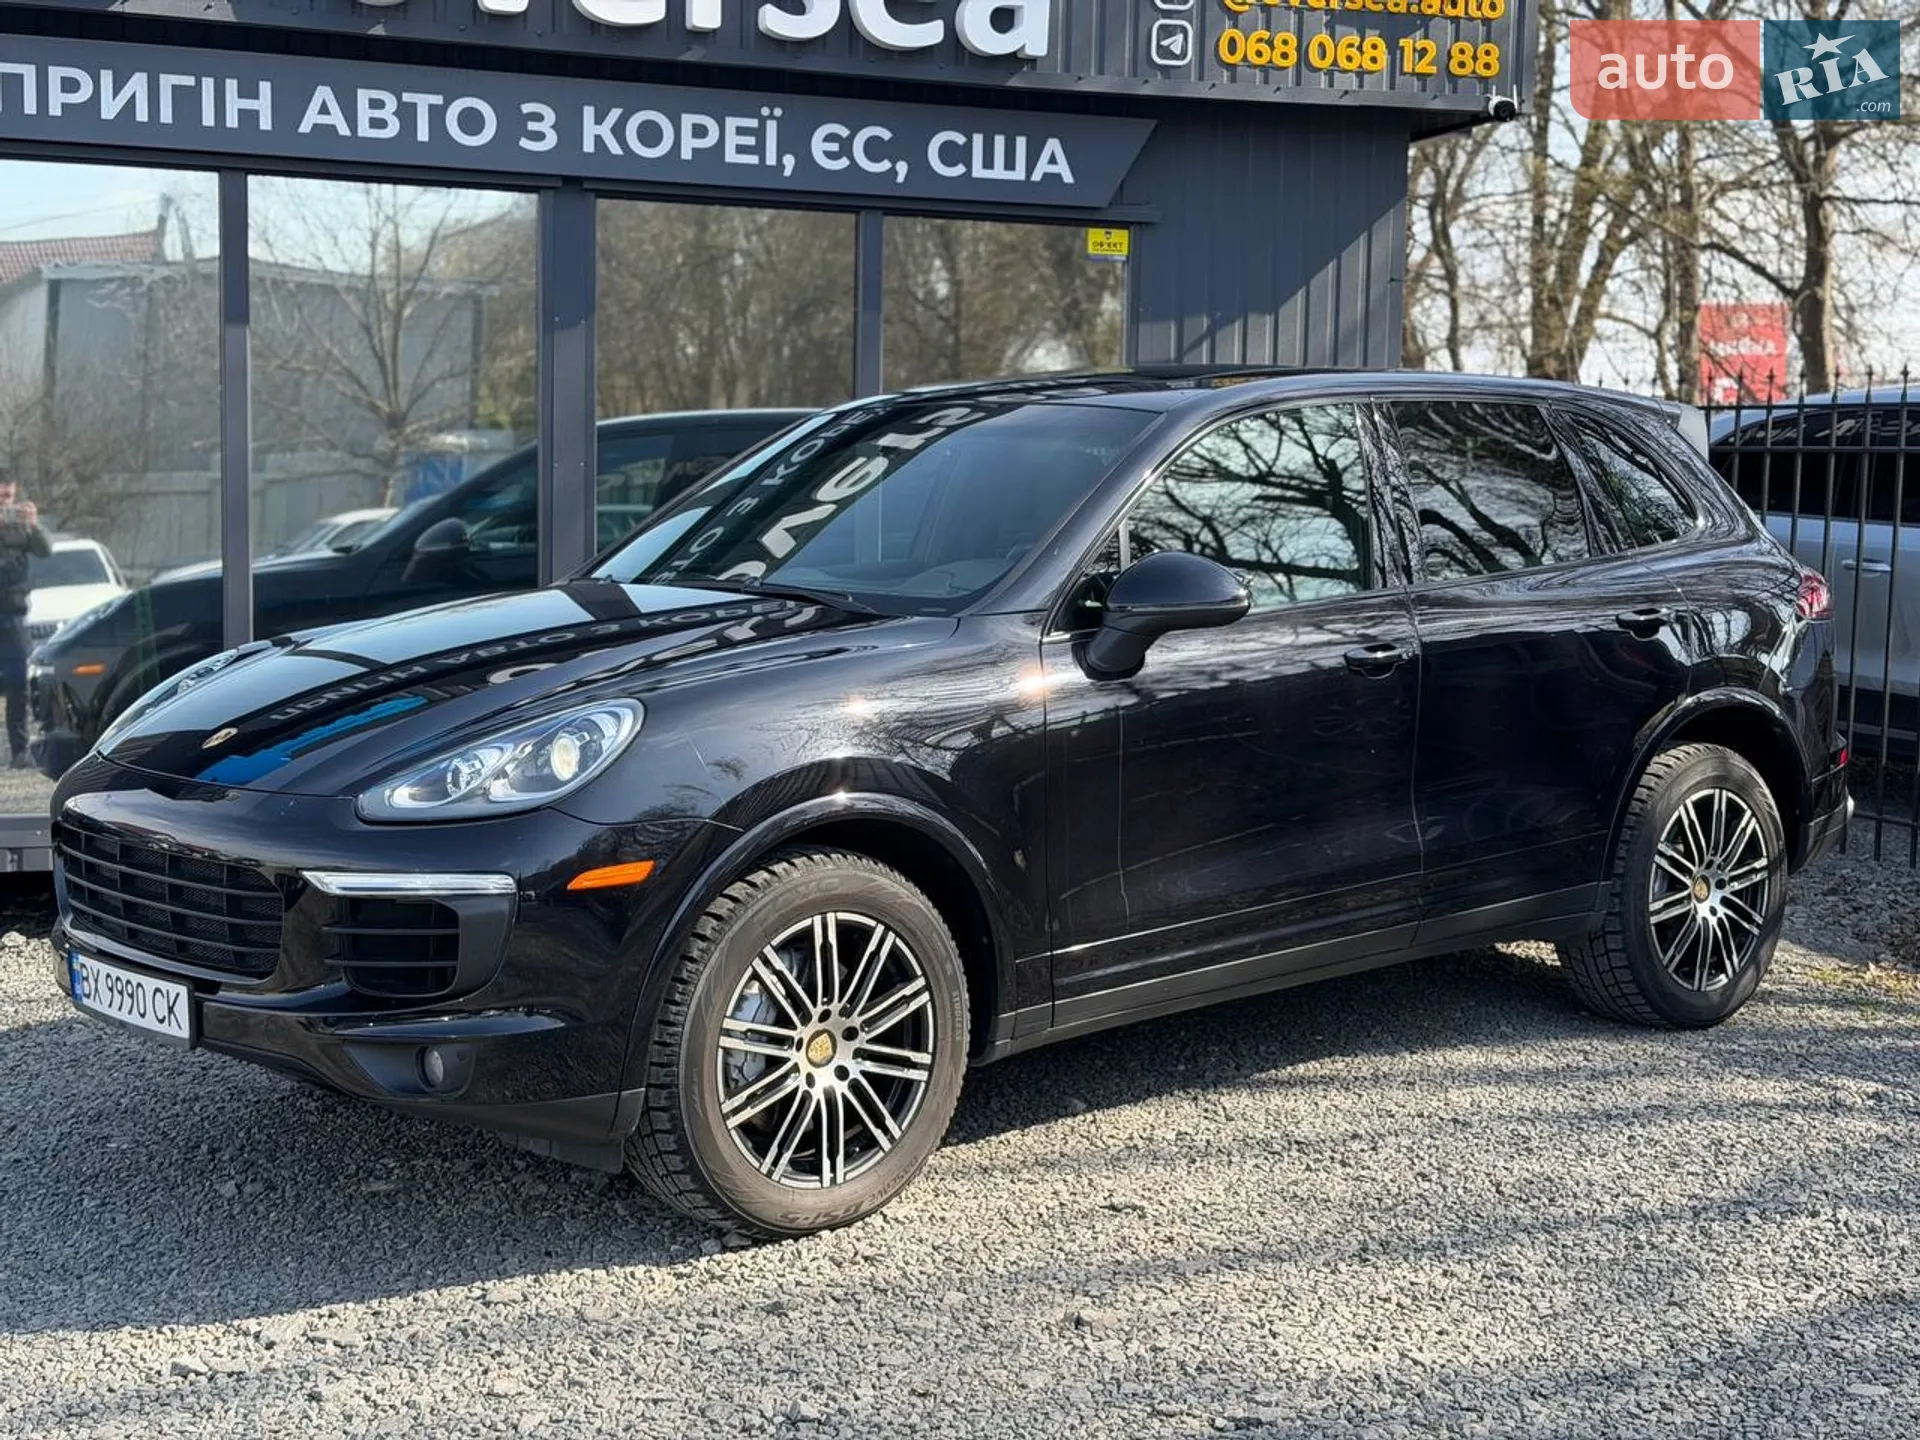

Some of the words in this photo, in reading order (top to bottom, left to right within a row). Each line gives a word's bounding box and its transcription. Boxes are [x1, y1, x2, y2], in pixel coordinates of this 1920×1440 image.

[1223, 0, 1505, 19] ea.auto
[1218, 28, 1298, 68] 068
[1308, 34, 1387, 72] 068
[1399, 38, 1438, 75] 12
[1449, 42, 1500, 78] 88
[0, 61, 273, 131] ПРИГІН
[298, 84, 498, 147] АВТО
[518, 101, 559, 152] З
[582, 105, 796, 178] КОРЕЇ,
[810, 122, 909, 184] ЄС,
[927, 129, 1076, 184] США
[104, 972, 147, 1019] 9990
[151, 986, 183, 1031] CK
